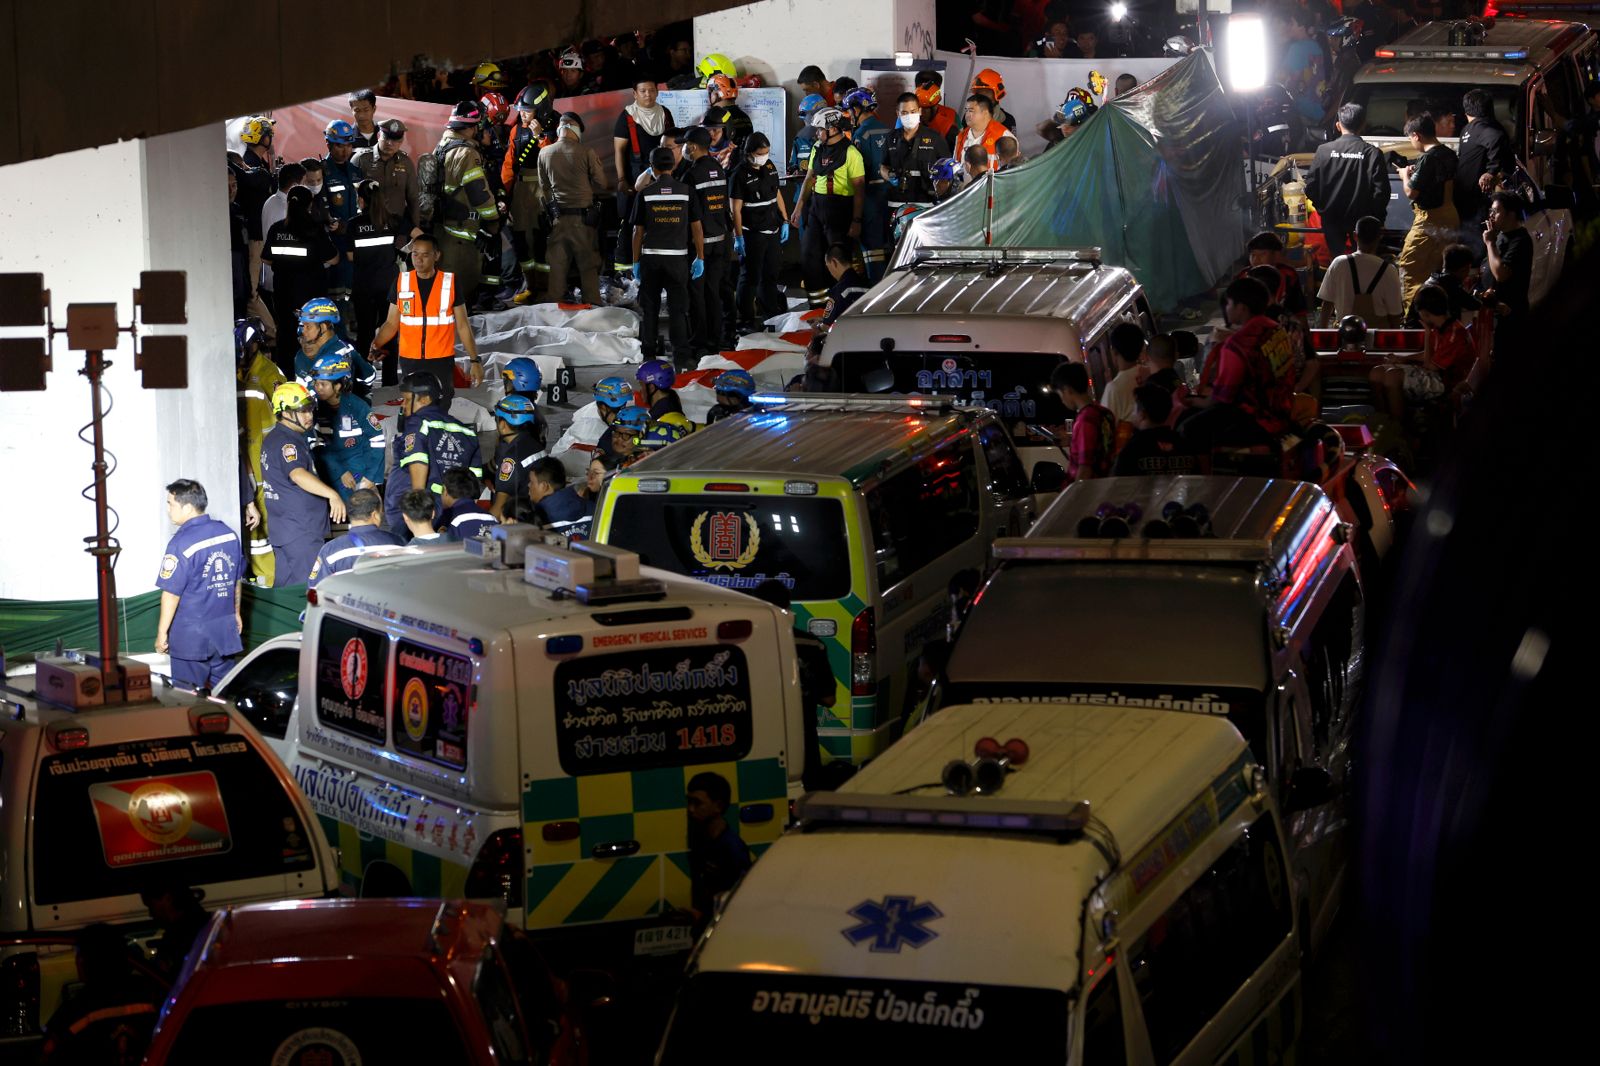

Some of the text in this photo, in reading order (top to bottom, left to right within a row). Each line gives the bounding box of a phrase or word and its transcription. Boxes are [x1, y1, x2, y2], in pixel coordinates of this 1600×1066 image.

[552, 386, 560, 402] 8
[561, 370, 569, 385] 6
[593, 627, 708, 648] EMERGENCY MEDICAL SERVICES
[567, 650, 738, 706] มูลนิธิป่อเต็กตึ๊ง
[563, 694, 748, 730] ช่วยชีวิต รักษาชีวิต สร้างชีวิต
[141, 746, 193, 763] อุบัติเหตุ
[574, 723, 737, 759] สายด่วน 1418
[320, 803, 338, 818] TECK
[340, 809, 358, 826] TUNG
[359, 816, 406, 843] FOUNDATION
[752, 987, 984, 1030] อาสามูลนิธิ ป่อเต็กตึ๊ง
